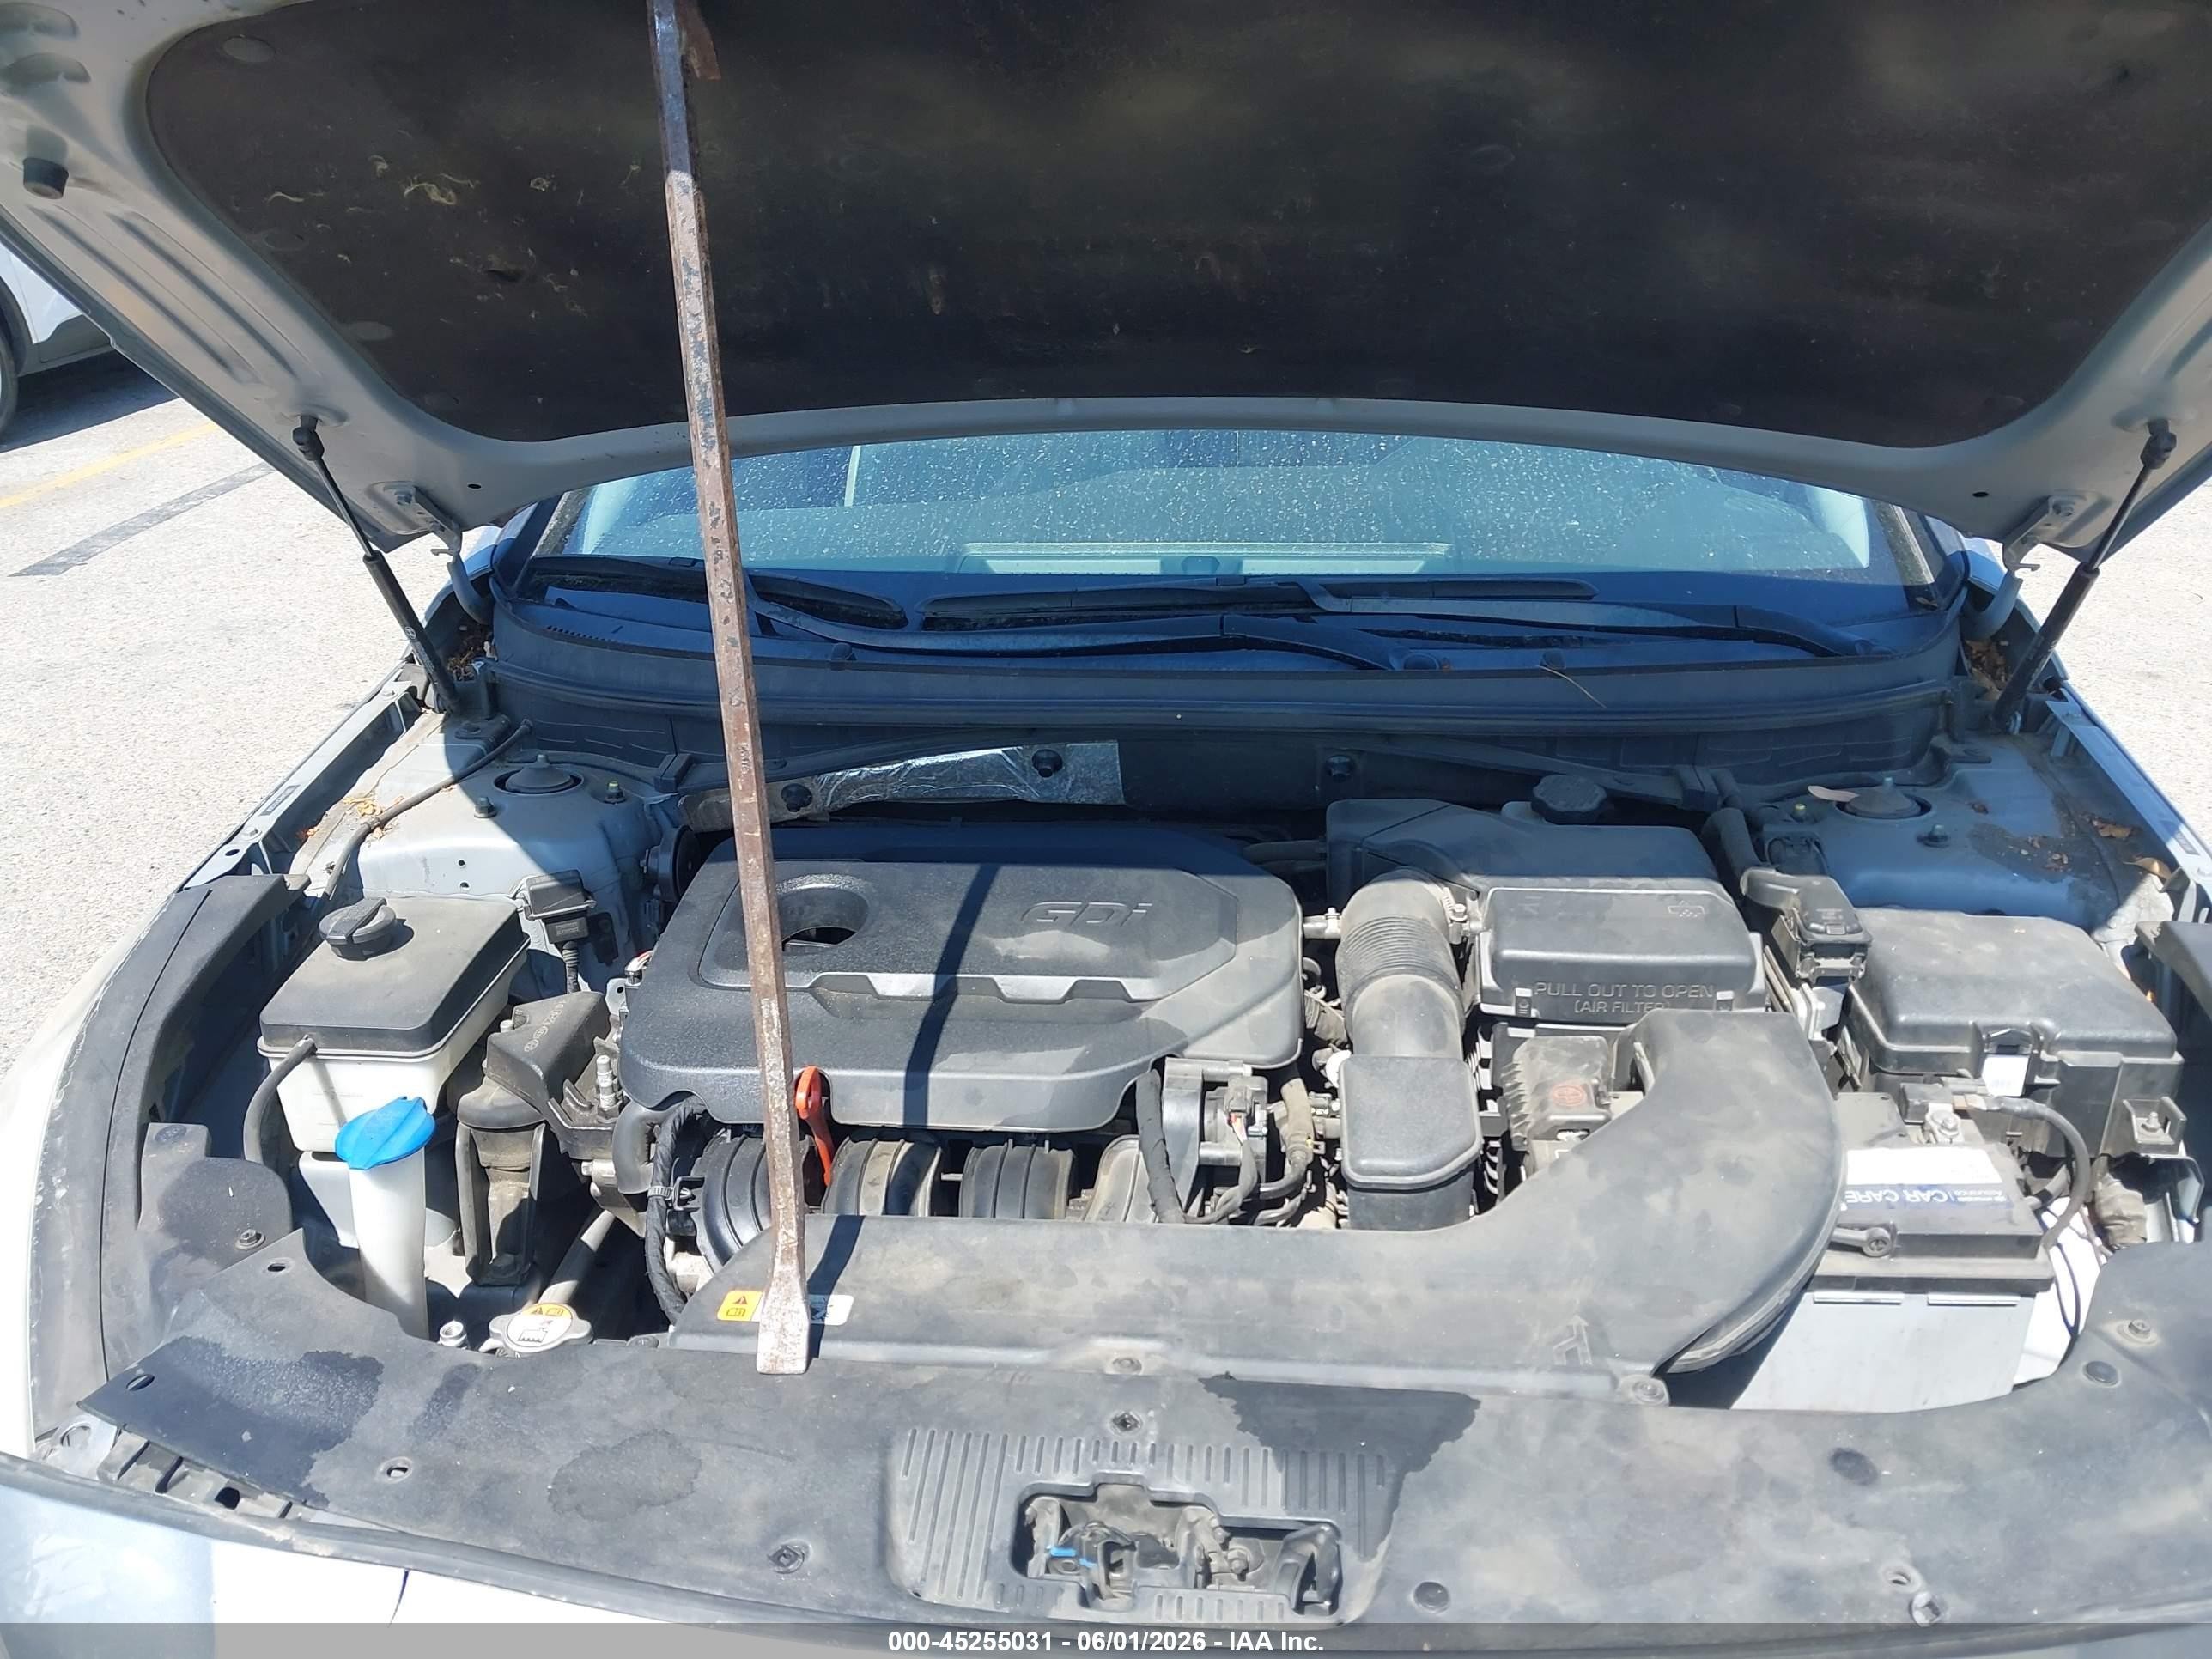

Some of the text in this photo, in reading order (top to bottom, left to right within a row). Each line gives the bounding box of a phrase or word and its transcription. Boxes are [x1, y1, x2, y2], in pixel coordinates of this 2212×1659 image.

[1020, 900, 1153, 927] GDi
[1534, 981, 1713, 999] PULL OUT TO OPEN
[1574, 1000, 1608, 1014] (AIR
[1844, 1189, 1899, 1202] CARE
[1903, 1189, 1949, 1202] CAR
